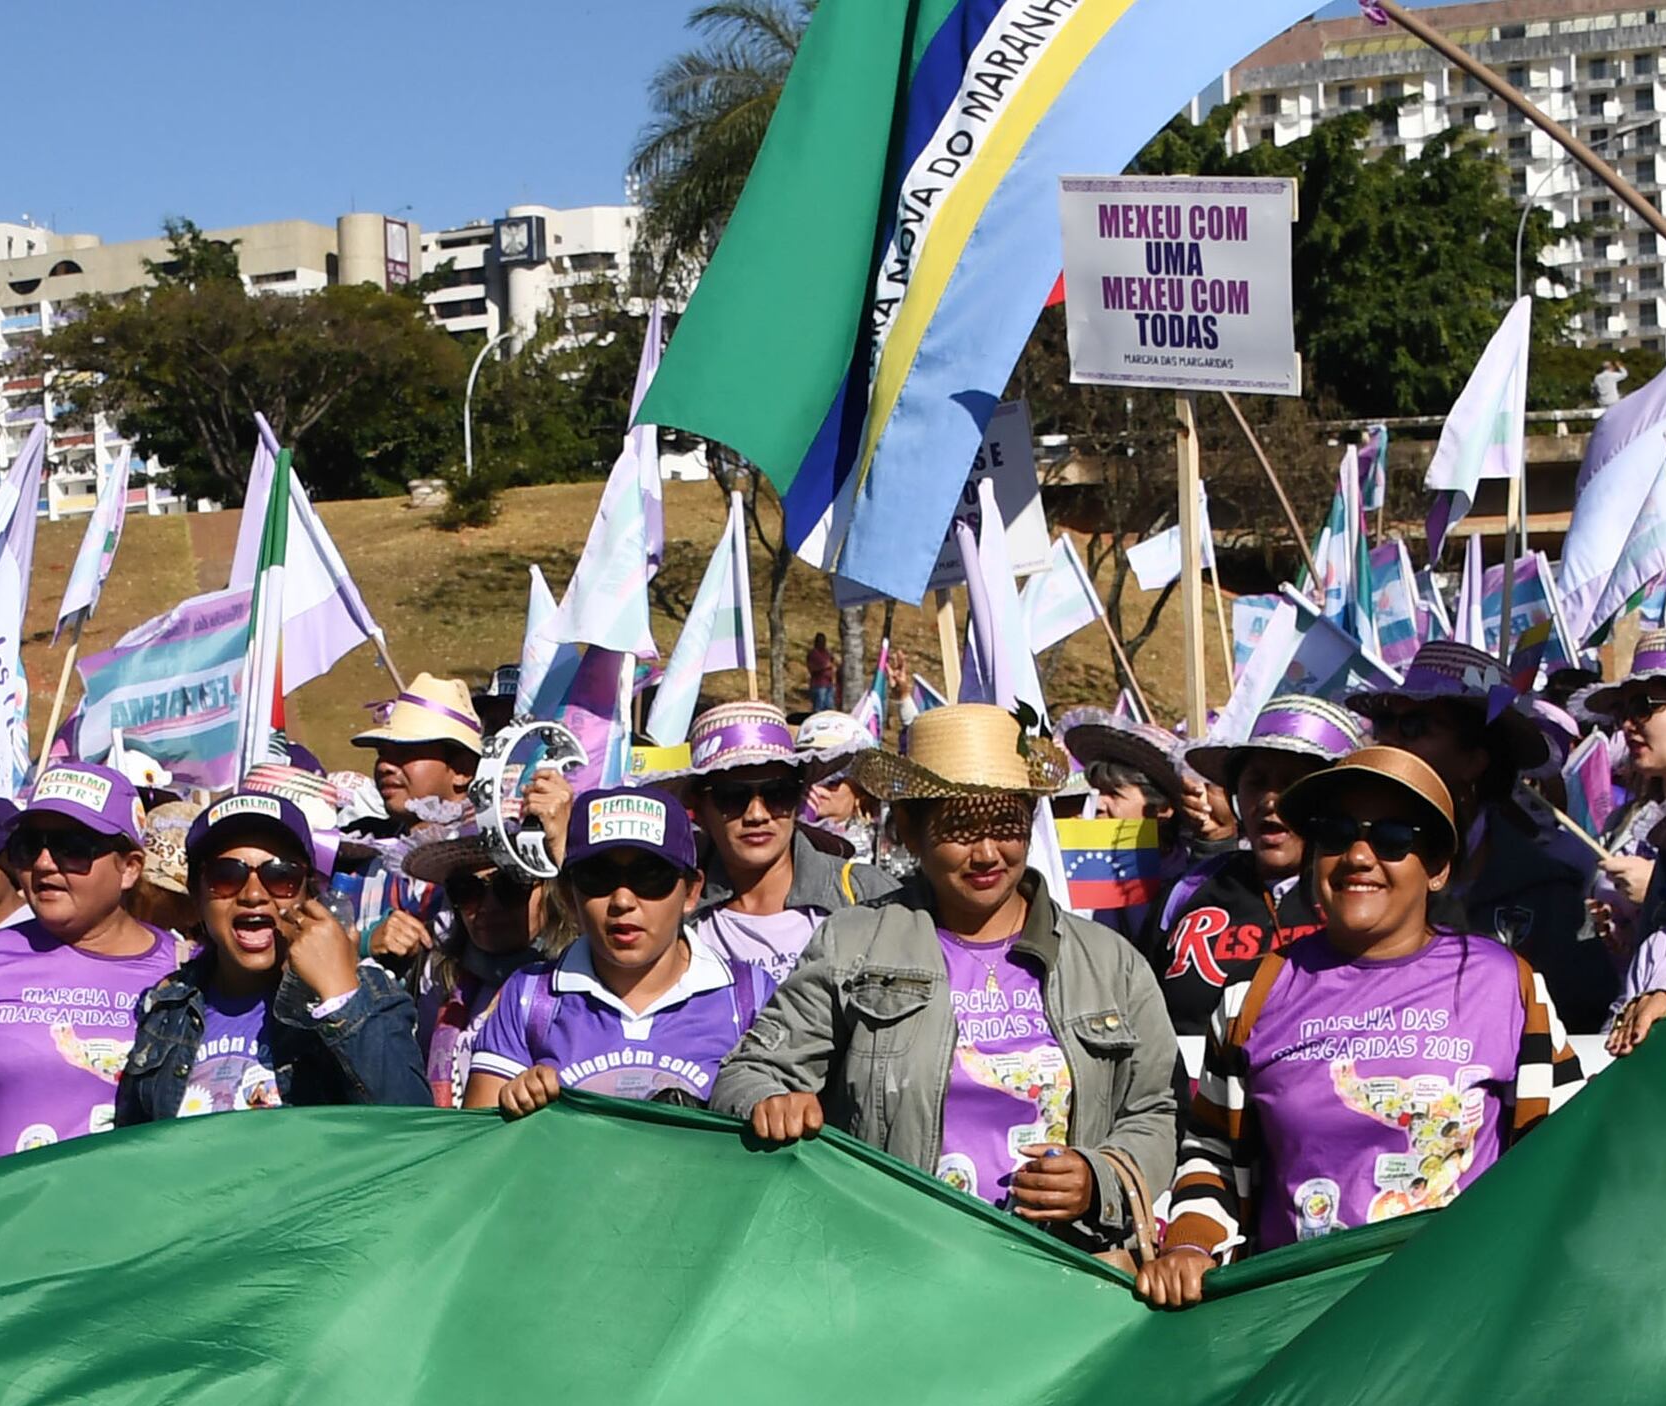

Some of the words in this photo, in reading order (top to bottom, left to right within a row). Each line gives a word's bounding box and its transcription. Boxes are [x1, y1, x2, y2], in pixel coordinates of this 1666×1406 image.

[886, 185, 943, 285] NOVA
[927, 129, 974, 179] DO
[960, 0, 1078, 123] MARANH
[1098, 204, 1182, 240] MEXEU
[1189, 205, 1249, 242] COM
[1145, 241, 1204, 277] UMA
[1101, 276, 1183, 313] MEXEU
[1191, 278, 1250, 315] COM
[1134, 312, 1219, 350] TODAS
[1124, 354, 1159, 365] MARCHA
[1160, 355, 1177, 367] DAS
[1179, 356, 1234, 369] MARGARIDAS
[771, 951, 797, 967] DAS
[21, 986, 111, 1008] MARCHA
[1013, 988, 1044, 1011] DA
[1401, 1008, 1449, 1033] DAS
[1422, 1038, 1473, 1064] 2019
[559, 1047, 654, 1086] Ninguém
[658, 1053, 710, 1089] solta
